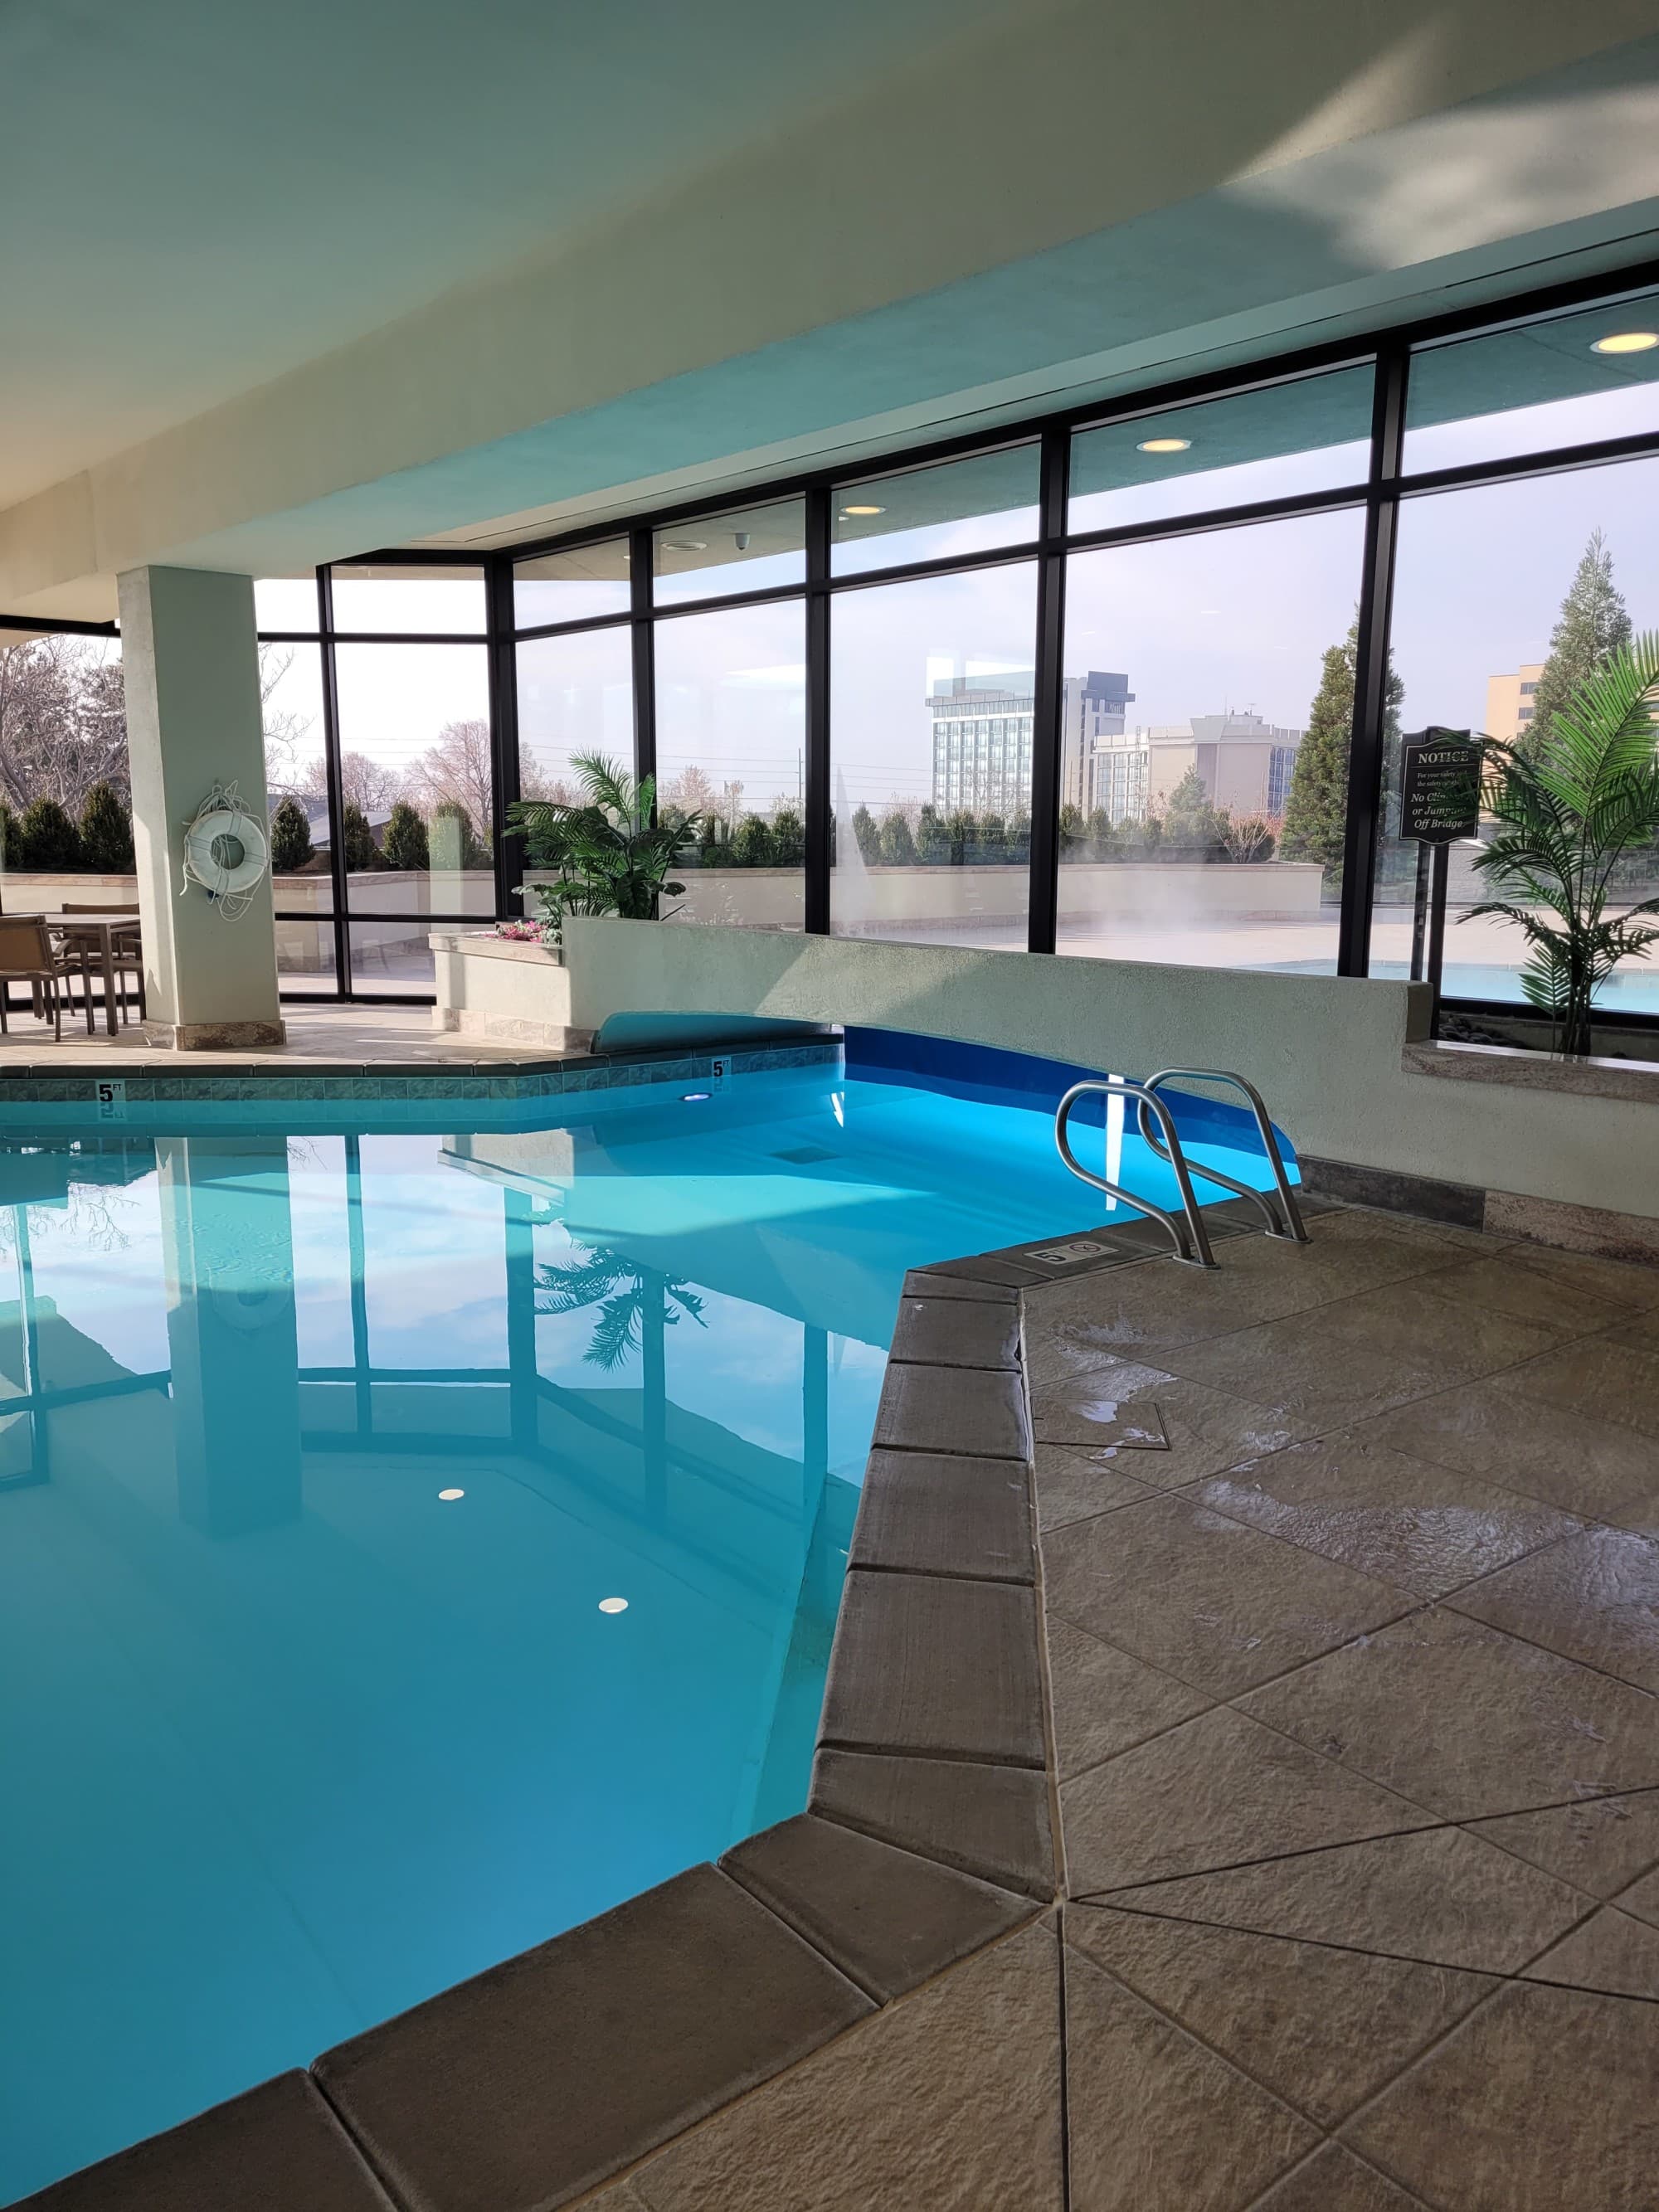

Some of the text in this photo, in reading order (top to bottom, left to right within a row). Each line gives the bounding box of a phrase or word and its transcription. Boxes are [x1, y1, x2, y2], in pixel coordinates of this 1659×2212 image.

[1418, 751, 1469, 764] NOTICE
[1410, 793, 1425, 803] No
[1413, 819, 1431, 830] Off
[713, 1060, 723, 1077] 5
[99, 1083, 114, 1102] 5
